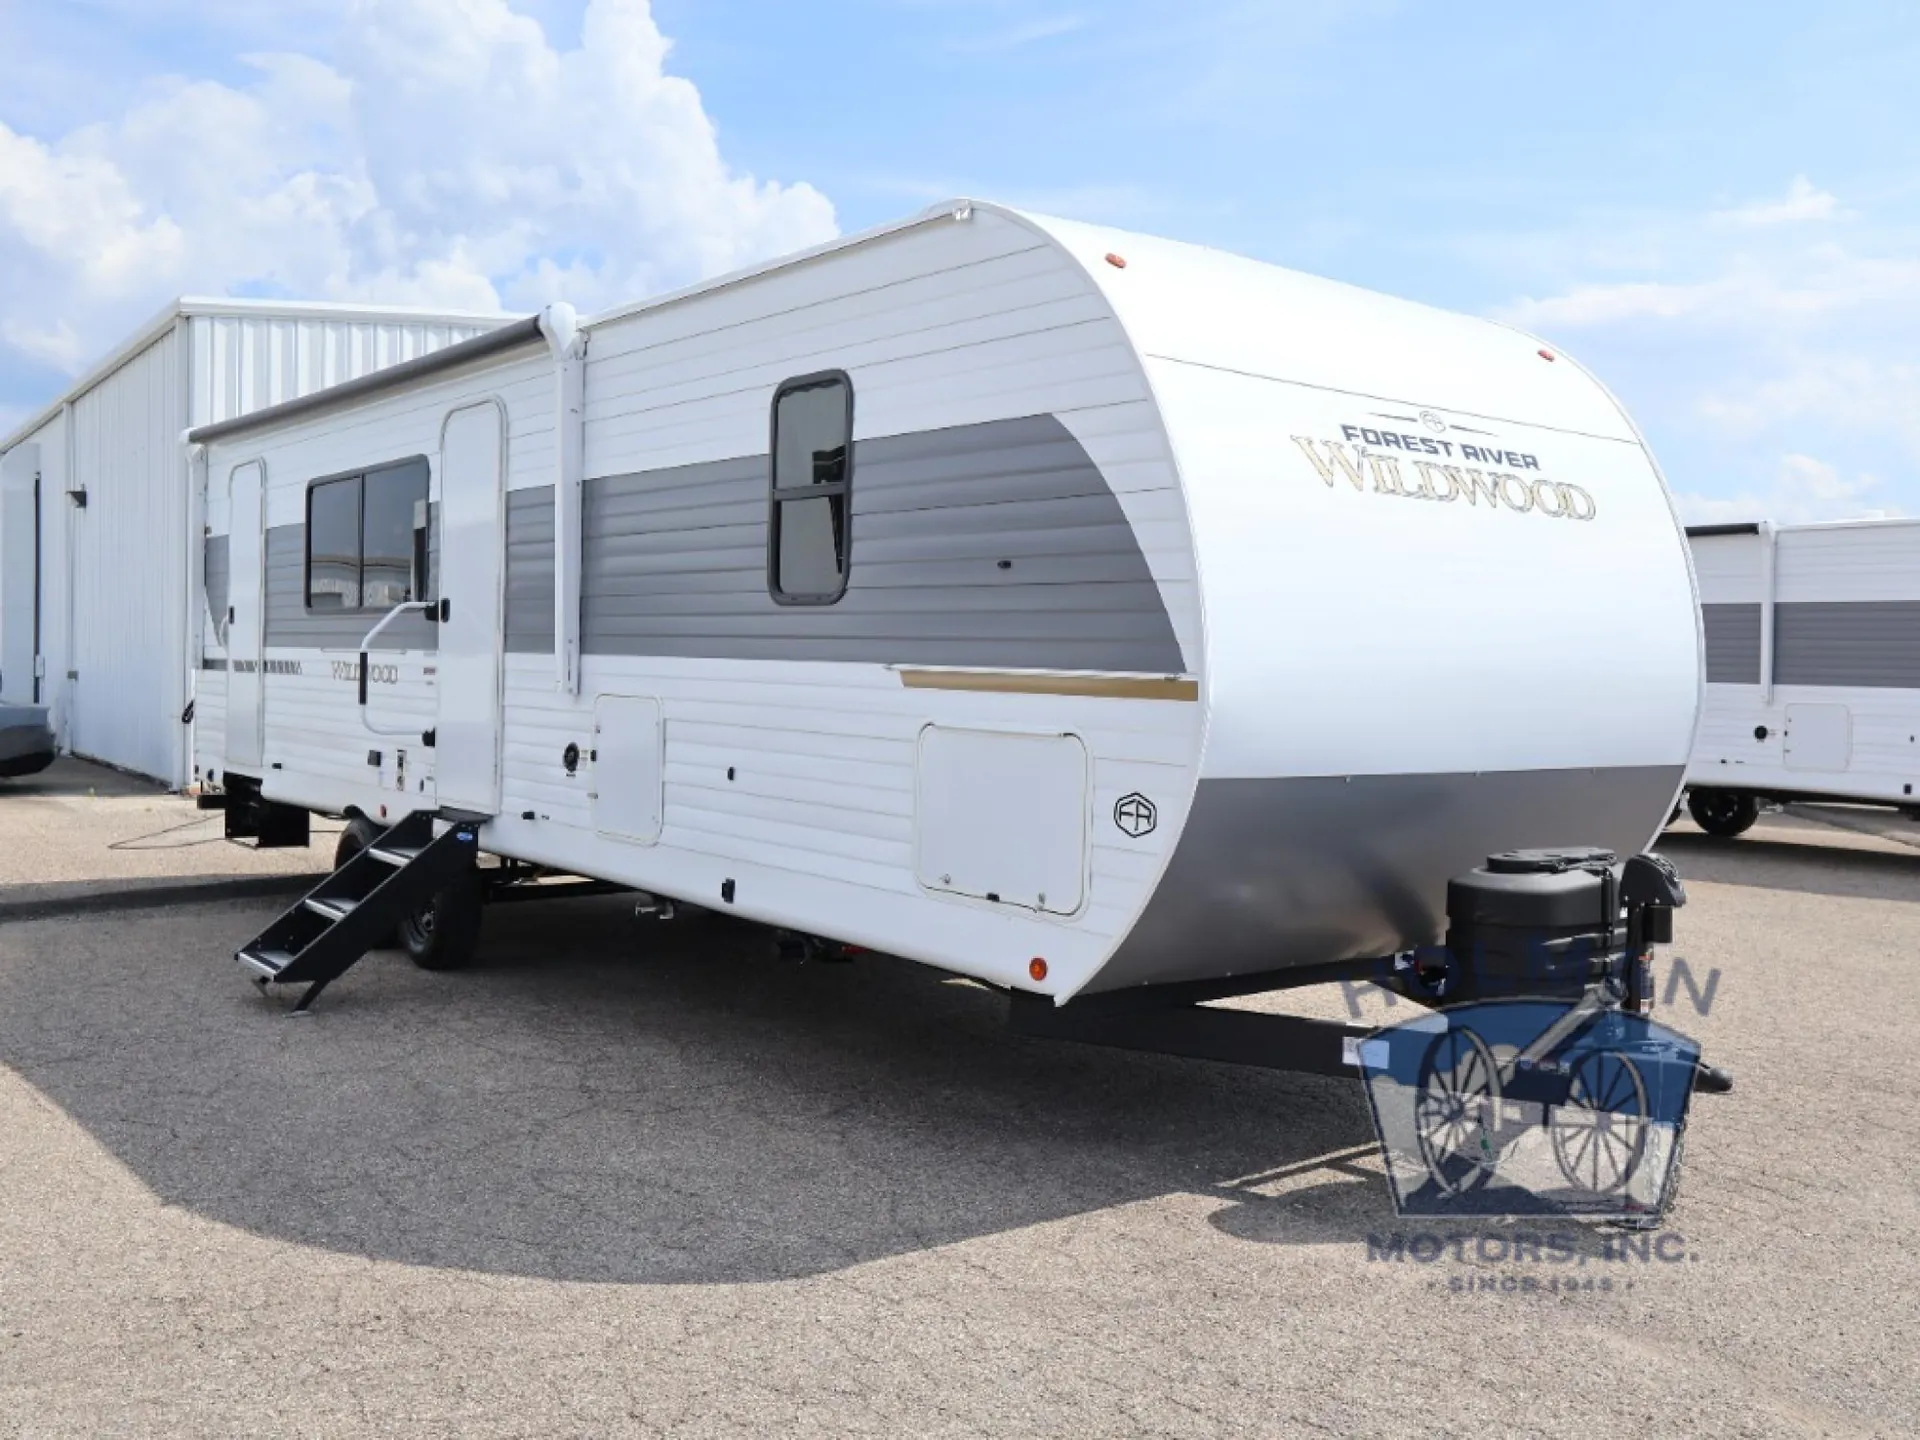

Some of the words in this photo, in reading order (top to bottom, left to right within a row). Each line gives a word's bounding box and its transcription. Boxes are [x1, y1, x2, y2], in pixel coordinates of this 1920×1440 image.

[1289, 433, 1597, 522] WILDWOOD
[1340, 423, 1454, 458] FOREST
[1460, 443, 1542, 472] RIVER
